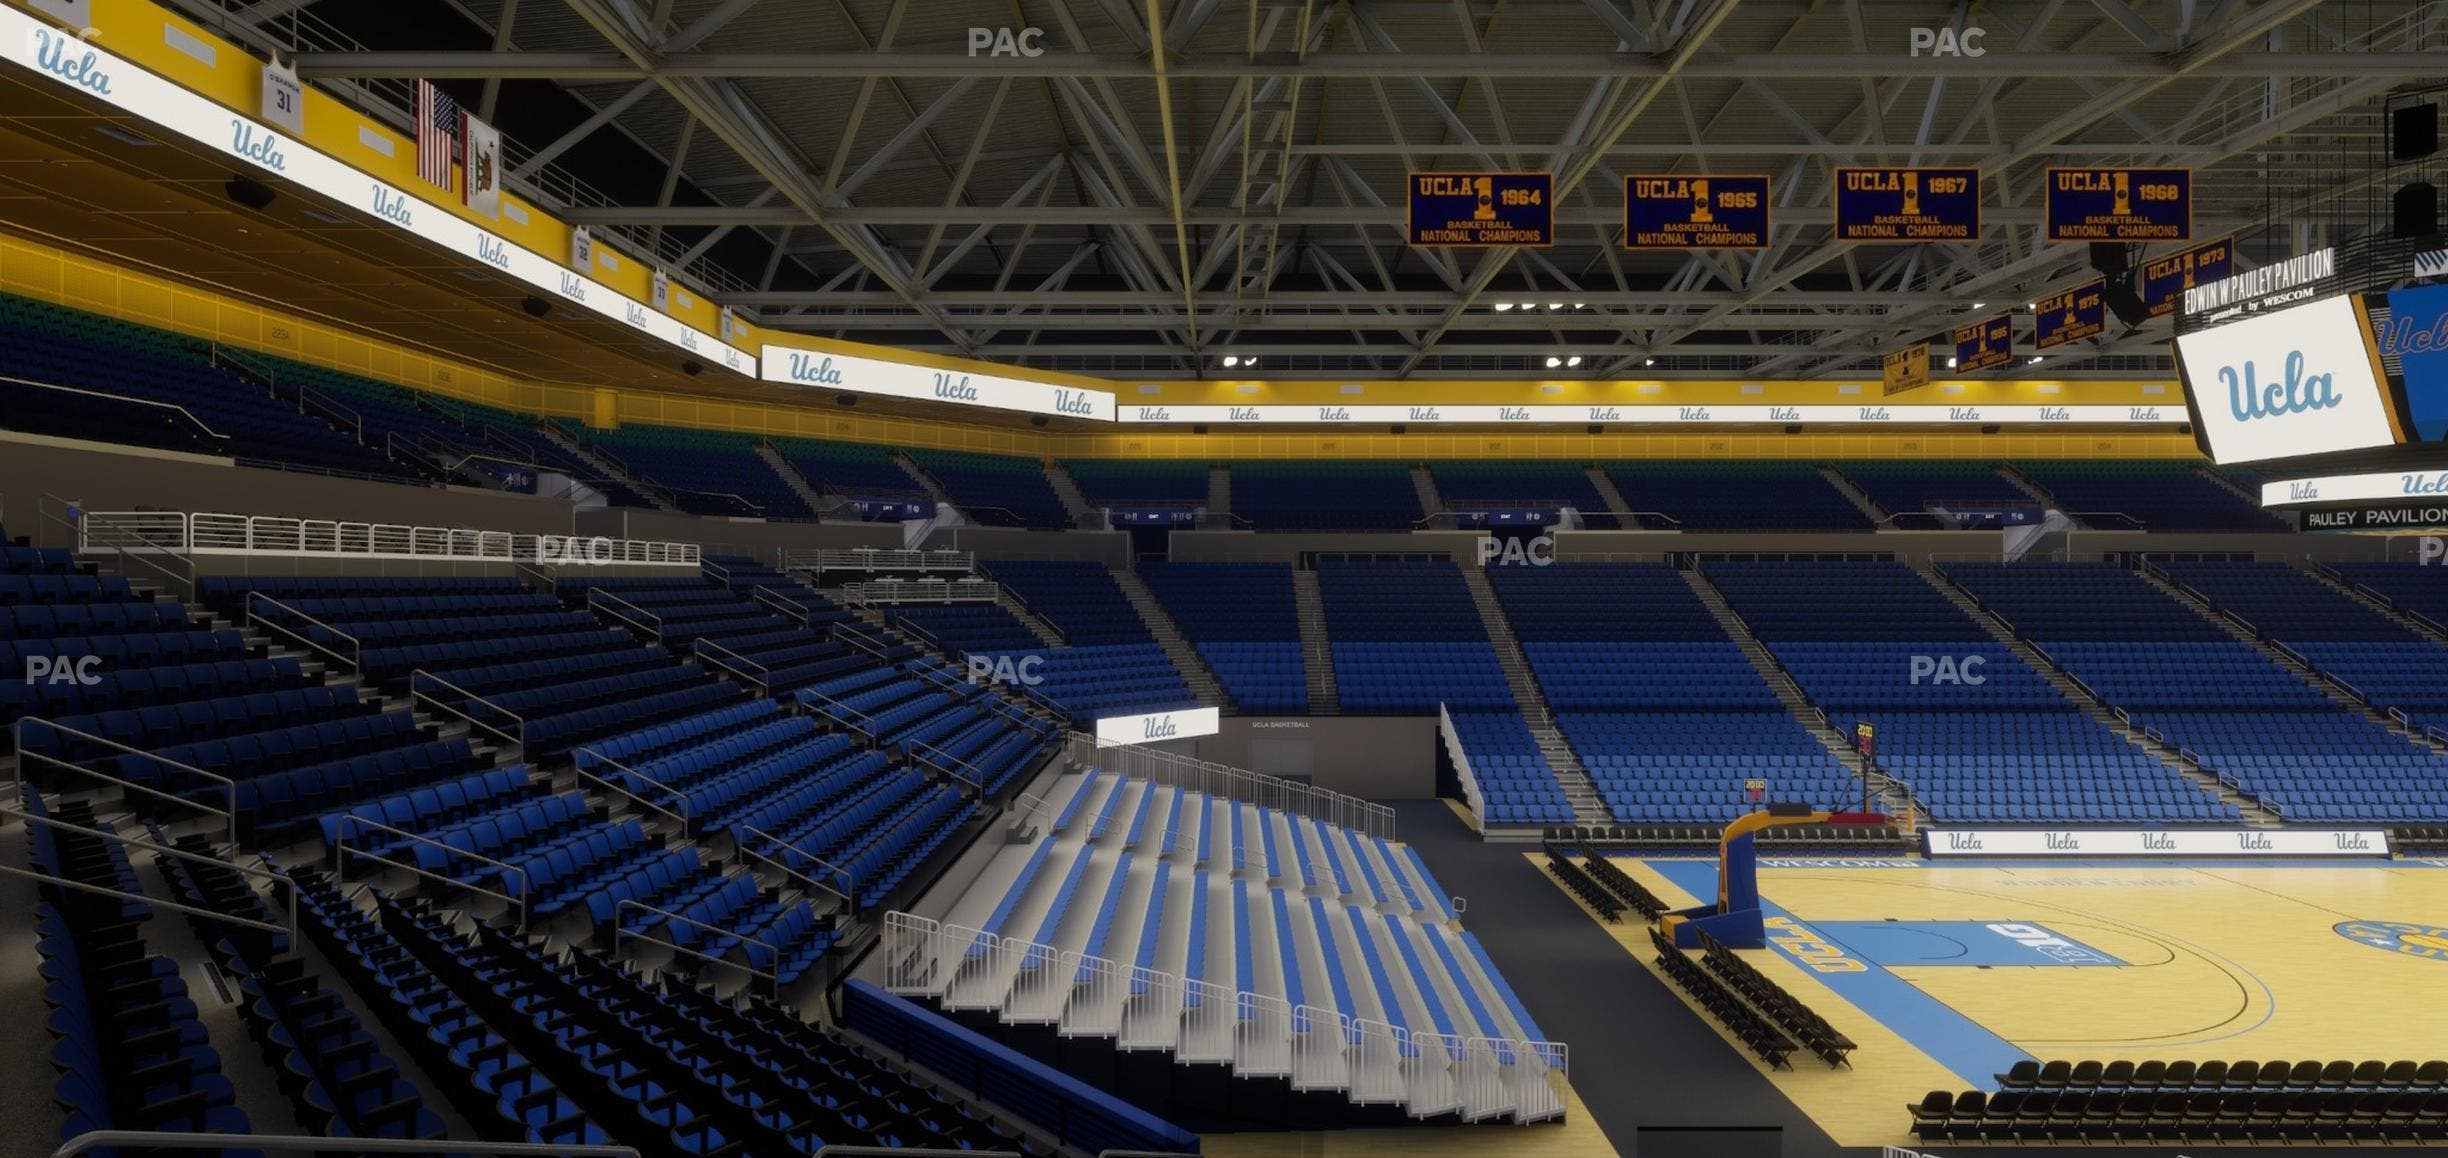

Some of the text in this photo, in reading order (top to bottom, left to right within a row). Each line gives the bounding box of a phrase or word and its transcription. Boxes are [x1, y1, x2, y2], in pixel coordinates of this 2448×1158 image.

[36, 29, 111, 95] Ucla
[277, 89, 291, 112] 31
[232, 120, 285, 171] Ucla
[1419, 177, 1473, 196] UCLA
[1500, 189, 1541, 206] 1964
[1847, 172, 1899, 191] UCLA
[1928, 177, 1967, 194] 1967
[2058, 172, 2111, 191] UCLA
[1636, 180, 1690, 199] UCLA
[1717, 192, 1757, 208] 1965
[372, 185, 413, 226] Ucla
[1447, 221, 1513, 230] BASKETBALL
[1664, 223, 1729, 232] BASKETBALL
[1848, 224, 1967, 237] NATIONAL CHAMPIONS
[1874, 215, 1940, 224] BASKETBALL
[2059, 224, 2178, 237] NATIONAL CHAMPIONS
[2085, 215, 2151, 224] BASKETBALL
[1421, 229, 1540, 242] NATIONAL CHAMPIONS
[1637, 233, 1757, 245] NATIONAL CHAMPIONS
[477, 233, 509, 269] Ucla
[2148, 257, 2181, 280] UCLA
[560, 272, 585, 301] Ucla
[2185, 247, 2332, 315] EDWIN W PAULEY PAVILION
[2248, 302, 2259, 311] by
[2264, 287, 2314, 307] WESCOM
[626, 302, 647, 329] Ucla
[680, 327, 698, 350] Ucla
[2375, 312, 2448, 356] Ucl
[726, 348, 740, 369] Ucla
[790, 353, 842, 385] Ucla
[934, 373, 978, 401] Ucla
[2218, 350, 2342, 422] Ucla
[1055, 389, 1092, 415] Ucla
[1139, 407, 2160, 421] Ucla Ucla Ucla Ucla Ucla Ucla Ucla Ucla Ucla Ucla Ucla Ucla
[2289, 481, 2318, 500] Ucla
[2402, 473, 2448, 494] Ucl
[2309, 511, 2358, 527] PAULEY
[1143, 715, 1176, 740] Ucla
[1948, 832, 1982, 850] Ucla
[2044, 832, 2079, 850] Ucla
[2141, 832, 2176, 850] Ucla
[2238, 832, 2272, 850] Ucla
[2334, 832, 2368, 850] Ucla
